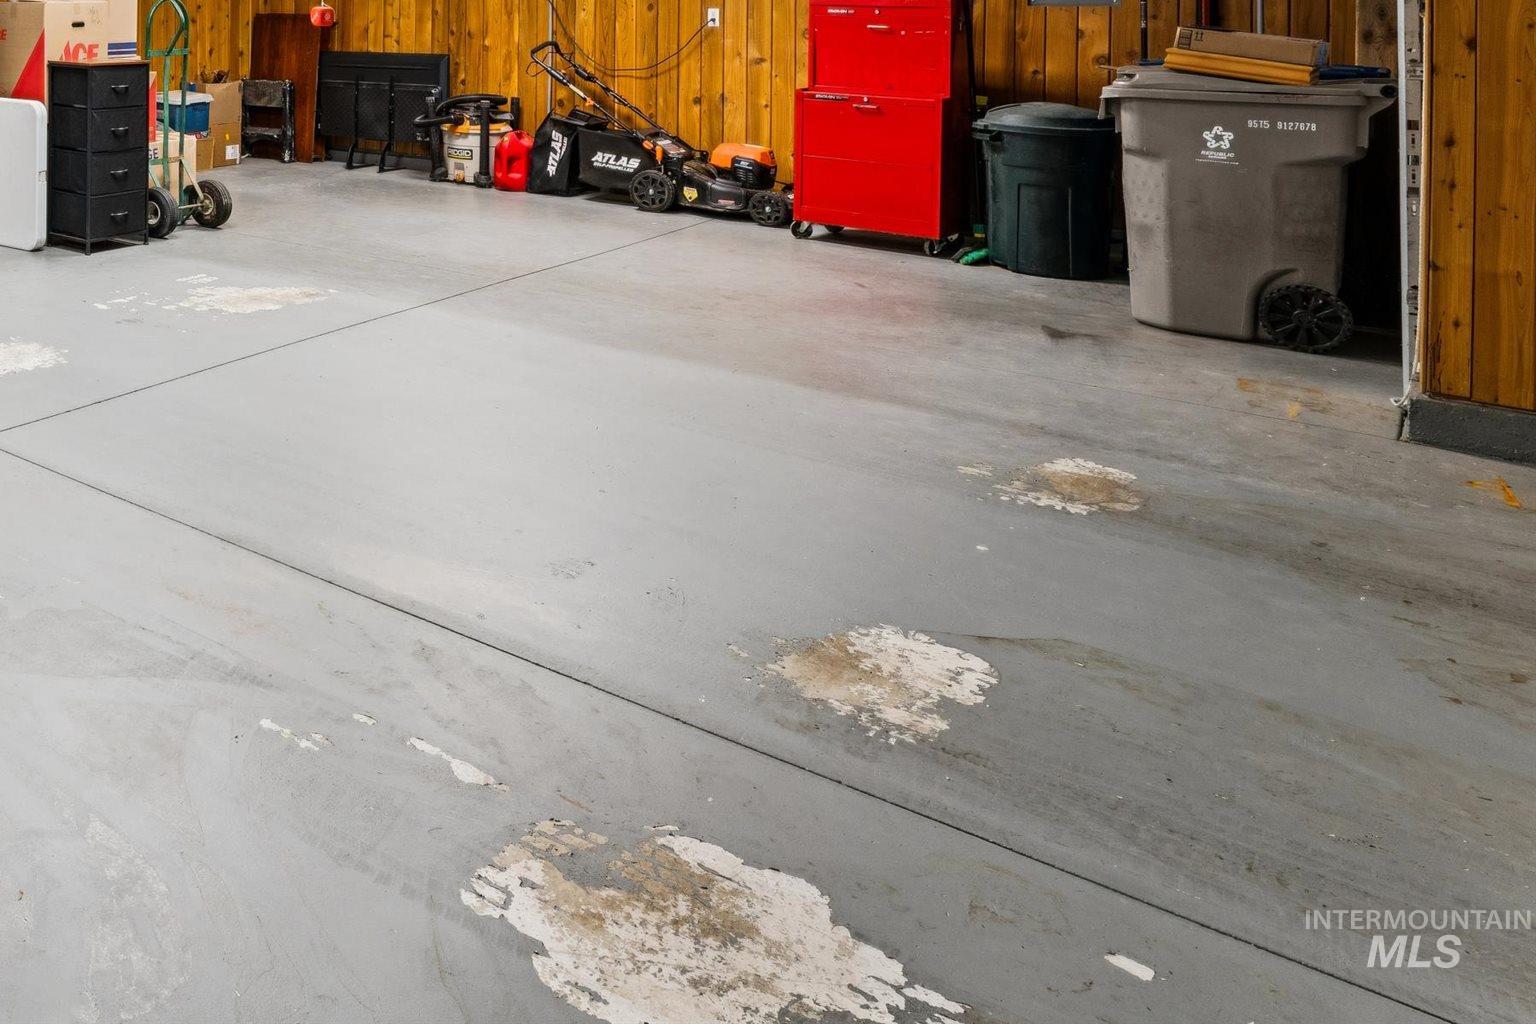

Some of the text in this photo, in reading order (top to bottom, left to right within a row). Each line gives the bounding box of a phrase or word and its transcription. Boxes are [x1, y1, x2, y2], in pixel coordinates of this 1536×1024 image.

[59, 40, 99, 62] ACE
[1247, 119, 1270, 129] 9575
[449, 148, 472, 156] RIDGID
[547, 129, 563, 177] ATLAS
[1200, 150, 1235, 158] REPUBLIC
[591, 151, 641, 169] ATLAS
